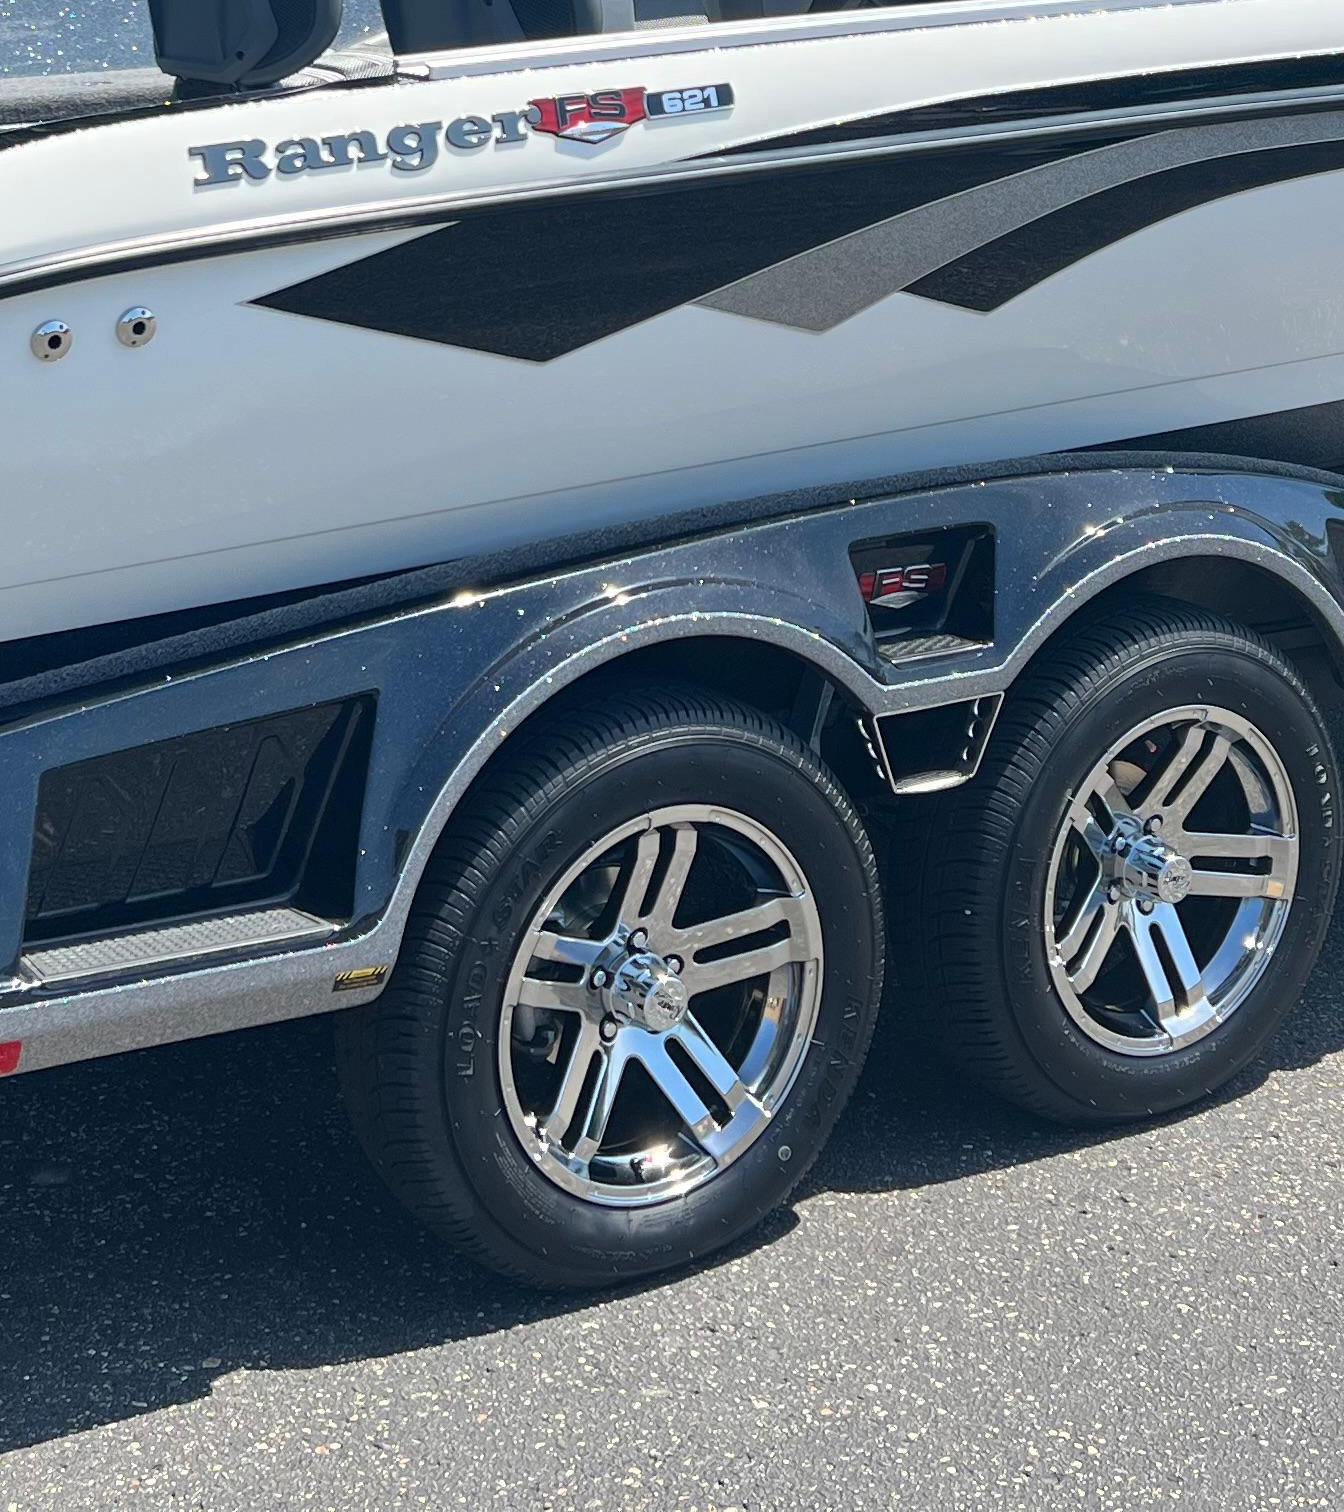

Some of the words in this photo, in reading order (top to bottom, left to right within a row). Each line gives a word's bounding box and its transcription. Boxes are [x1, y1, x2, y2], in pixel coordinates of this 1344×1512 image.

[189, 105, 542, 186] Ranger
[557, 90, 627, 128] FS
[661, 87, 719, 114] 621
[871, 564, 931, 599] FS
